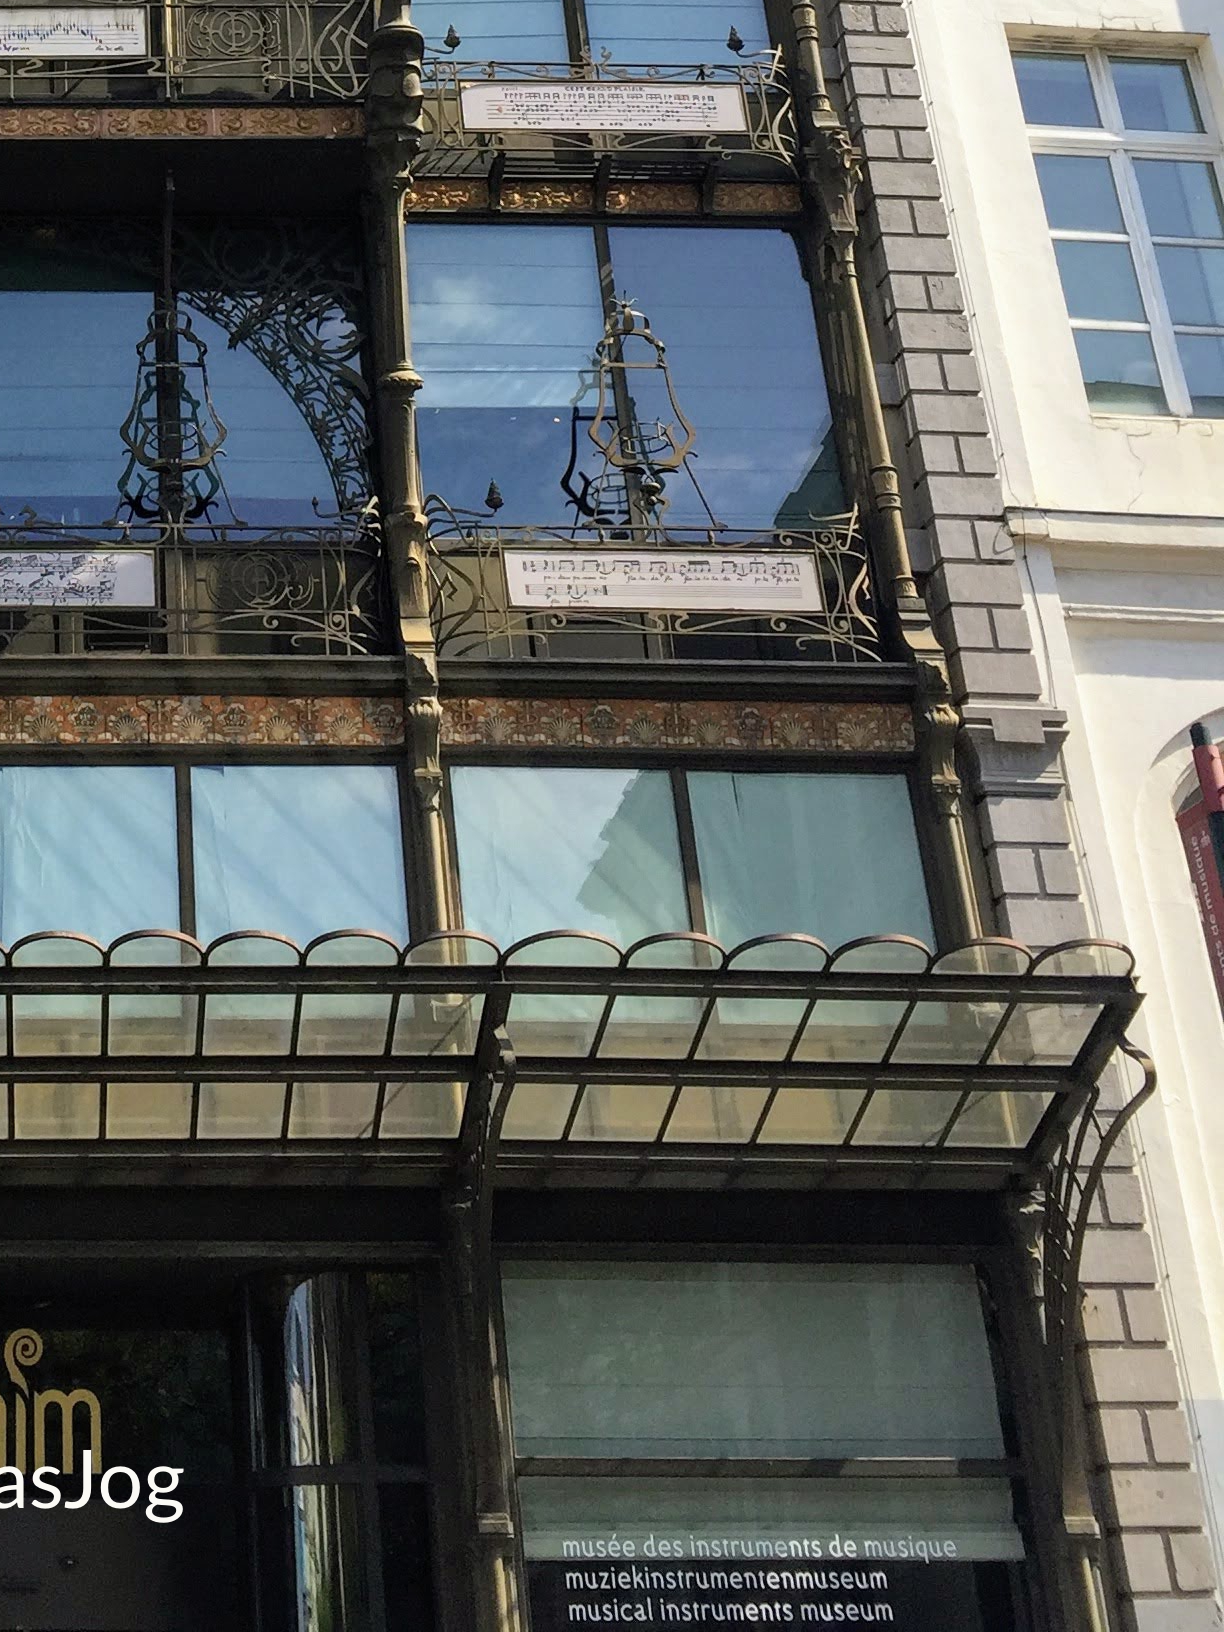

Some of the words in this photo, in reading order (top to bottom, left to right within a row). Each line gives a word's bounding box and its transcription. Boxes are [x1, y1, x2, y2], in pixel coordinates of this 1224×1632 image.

[1191, 836, 1213, 910] musique
[562, 1533, 636, 1558] musée
[643, 1533, 684, 1558] des
[689, 1535, 823, 1558] instruments
[829, 1534, 857, 1558] de
[864, 1536, 957, 1564] musique
[565, 1565, 888, 1590] muziekinstrumentenmuseum
[568, 1597, 654, 1622] musical
[659, 1598, 794, 1622] instruments
[800, 1602, 894, 1622] museum
